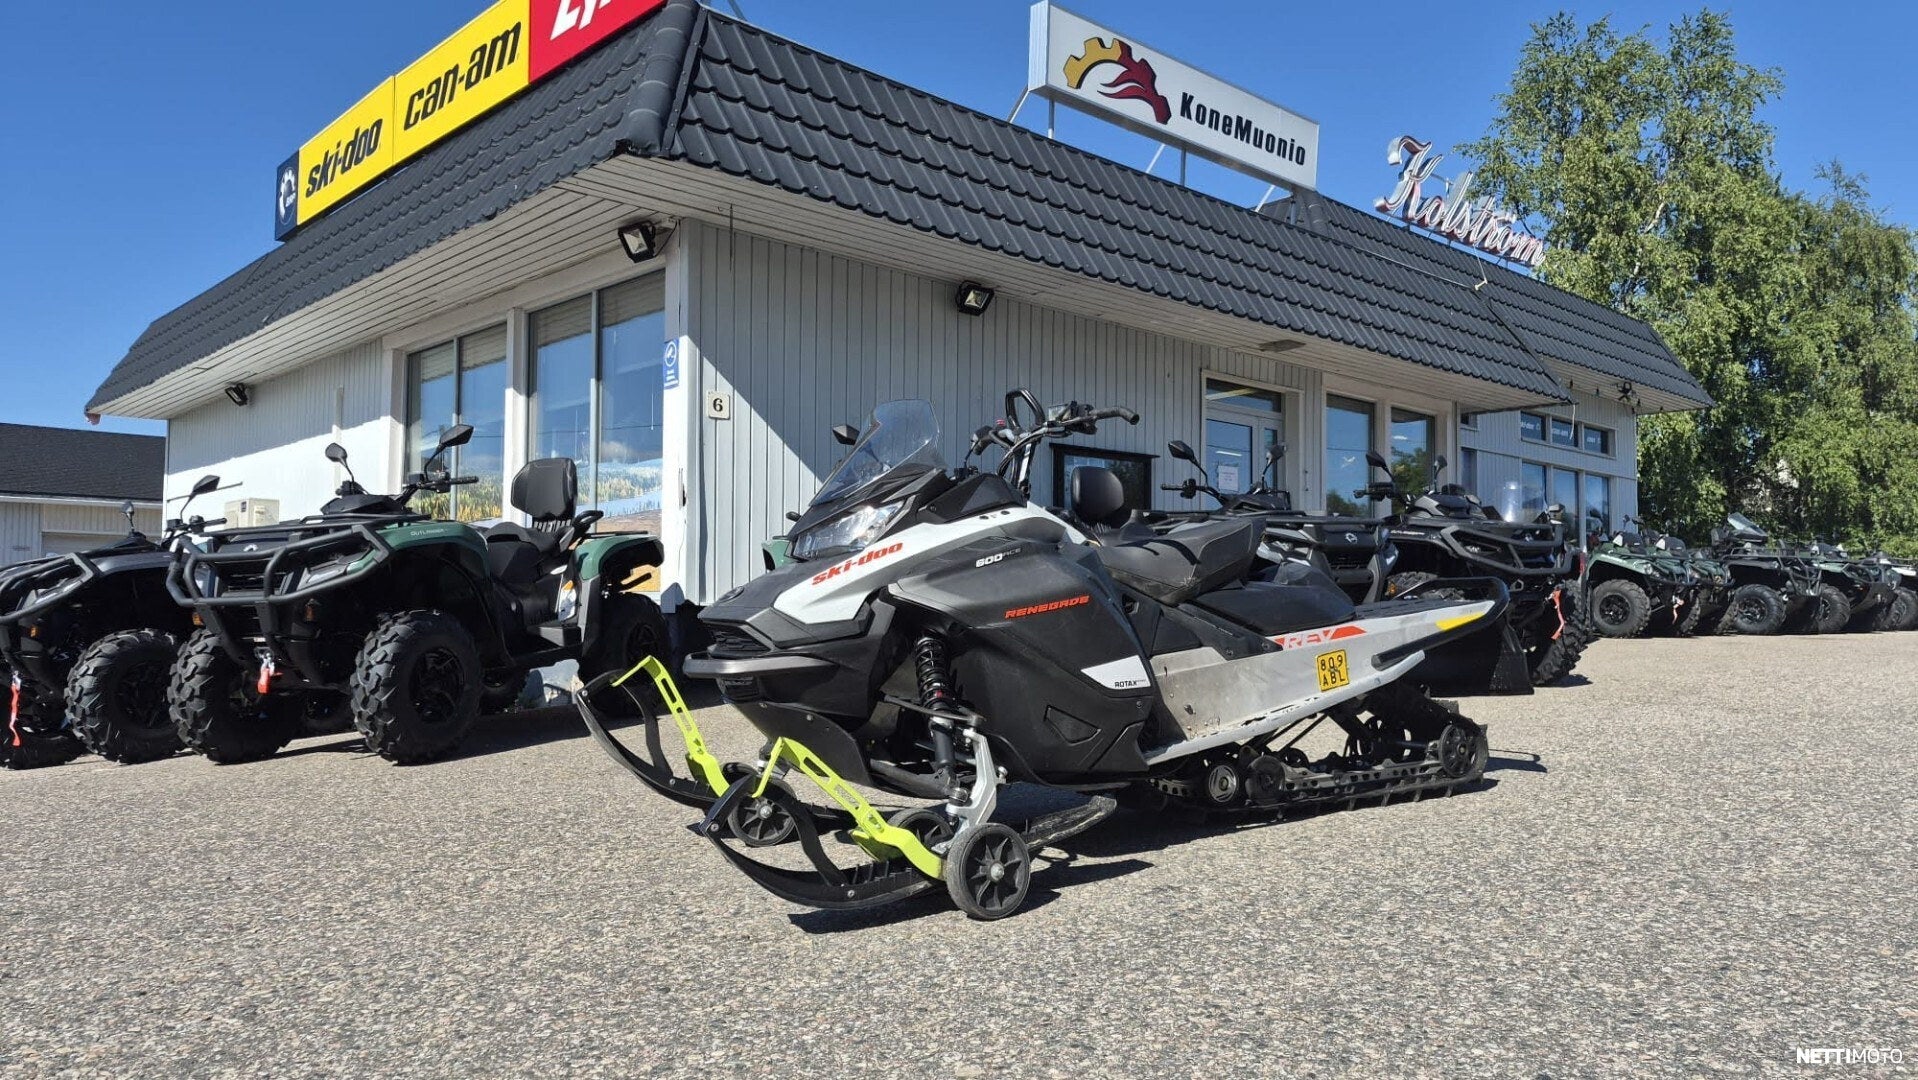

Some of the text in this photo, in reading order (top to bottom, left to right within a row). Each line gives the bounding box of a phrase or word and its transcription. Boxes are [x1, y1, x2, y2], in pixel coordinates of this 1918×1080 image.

[403, 21, 522, 131] can-am
[1180, 91, 1306, 166] KoneMuonio
[305, 118, 383, 198] ski-doo
[712, 397, 724, 413] 6
[812, 542, 904, 586] ski-doo
[1005, 595, 1090, 619] RENEGADE
[1320, 654, 1344, 671] 809
[1323, 670, 1346, 687] ABL
